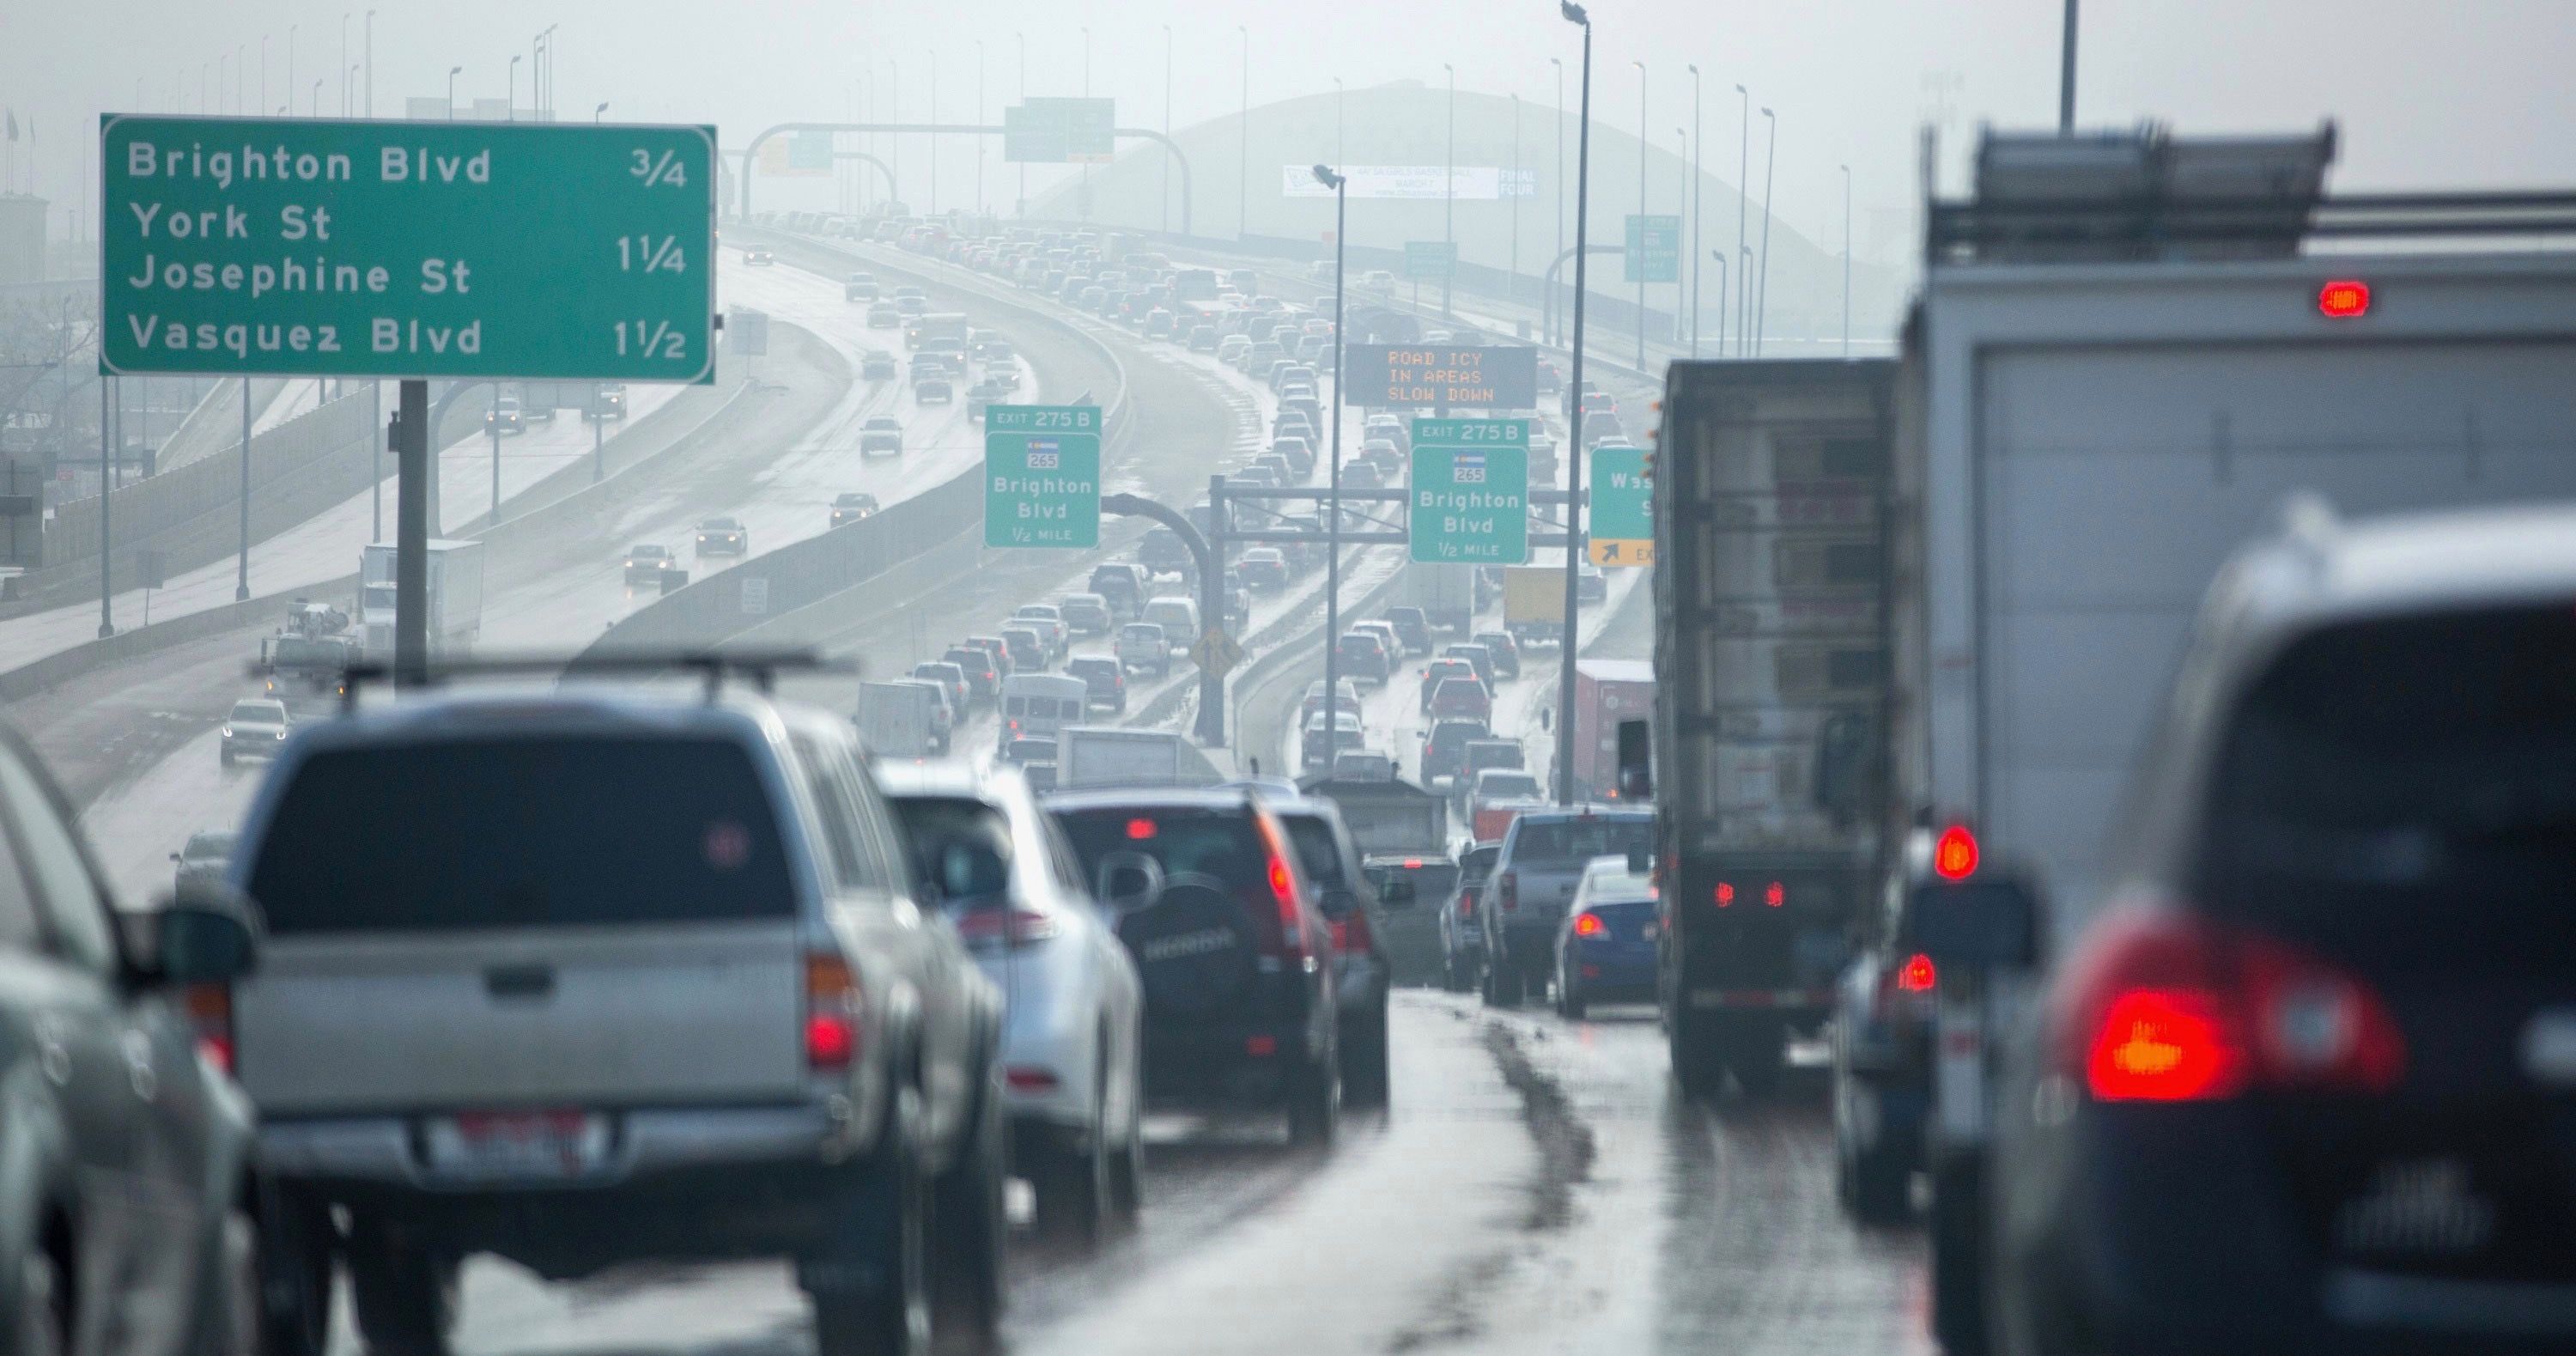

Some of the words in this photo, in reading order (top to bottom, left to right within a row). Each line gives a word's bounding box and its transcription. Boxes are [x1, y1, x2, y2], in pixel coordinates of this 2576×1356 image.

[129, 143, 350, 189] Brighton
[381, 148, 491, 182] Blvd
[1500, 170, 1535, 181] FINAL
[1500, 184, 1534, 196] FOUR
[130, 203, 248, 238] York
[281, 205, 331, 240] St
[129, 254, 389, 299] Josephine
[421, 258, 470, 293] St
[129, 314, 341, 359] Vasquez
[371, 319, 482, 354] Blvd
[1388, 351, 1435, 365] ROAD
[1449, 352, 1482, 366] ICY
[1390, 369, 1411, 382] IN
[1424, 370, 1482, 384] AREAS
[1388, 387, 1435, 400] SLOW
[1449, 388, 1493, 401] DOWN
[997, 413, 1028, 423] EXIT
[1035, 412, 1072, 427] 275
[1078, 412, 1091, 427] B
[1422, 427, 1454, 437] EXIT
[1461, 425, 1500, 440] 275
[1506, 426, 1518, 440] B
[1030, 455, 1056, 466] 265
[1457, 469, 1483, 481] 265
[994, 477, 1091, 497] Brighton
[1420, 491, 1518, 512] Brighton
[1018, 502, 1067, 518] Blvd
[1444, 516, 1493, 533] Blvd
[1038, 530, 1072, 541] MILE
[1465, 544, 1499, 556] MILE
